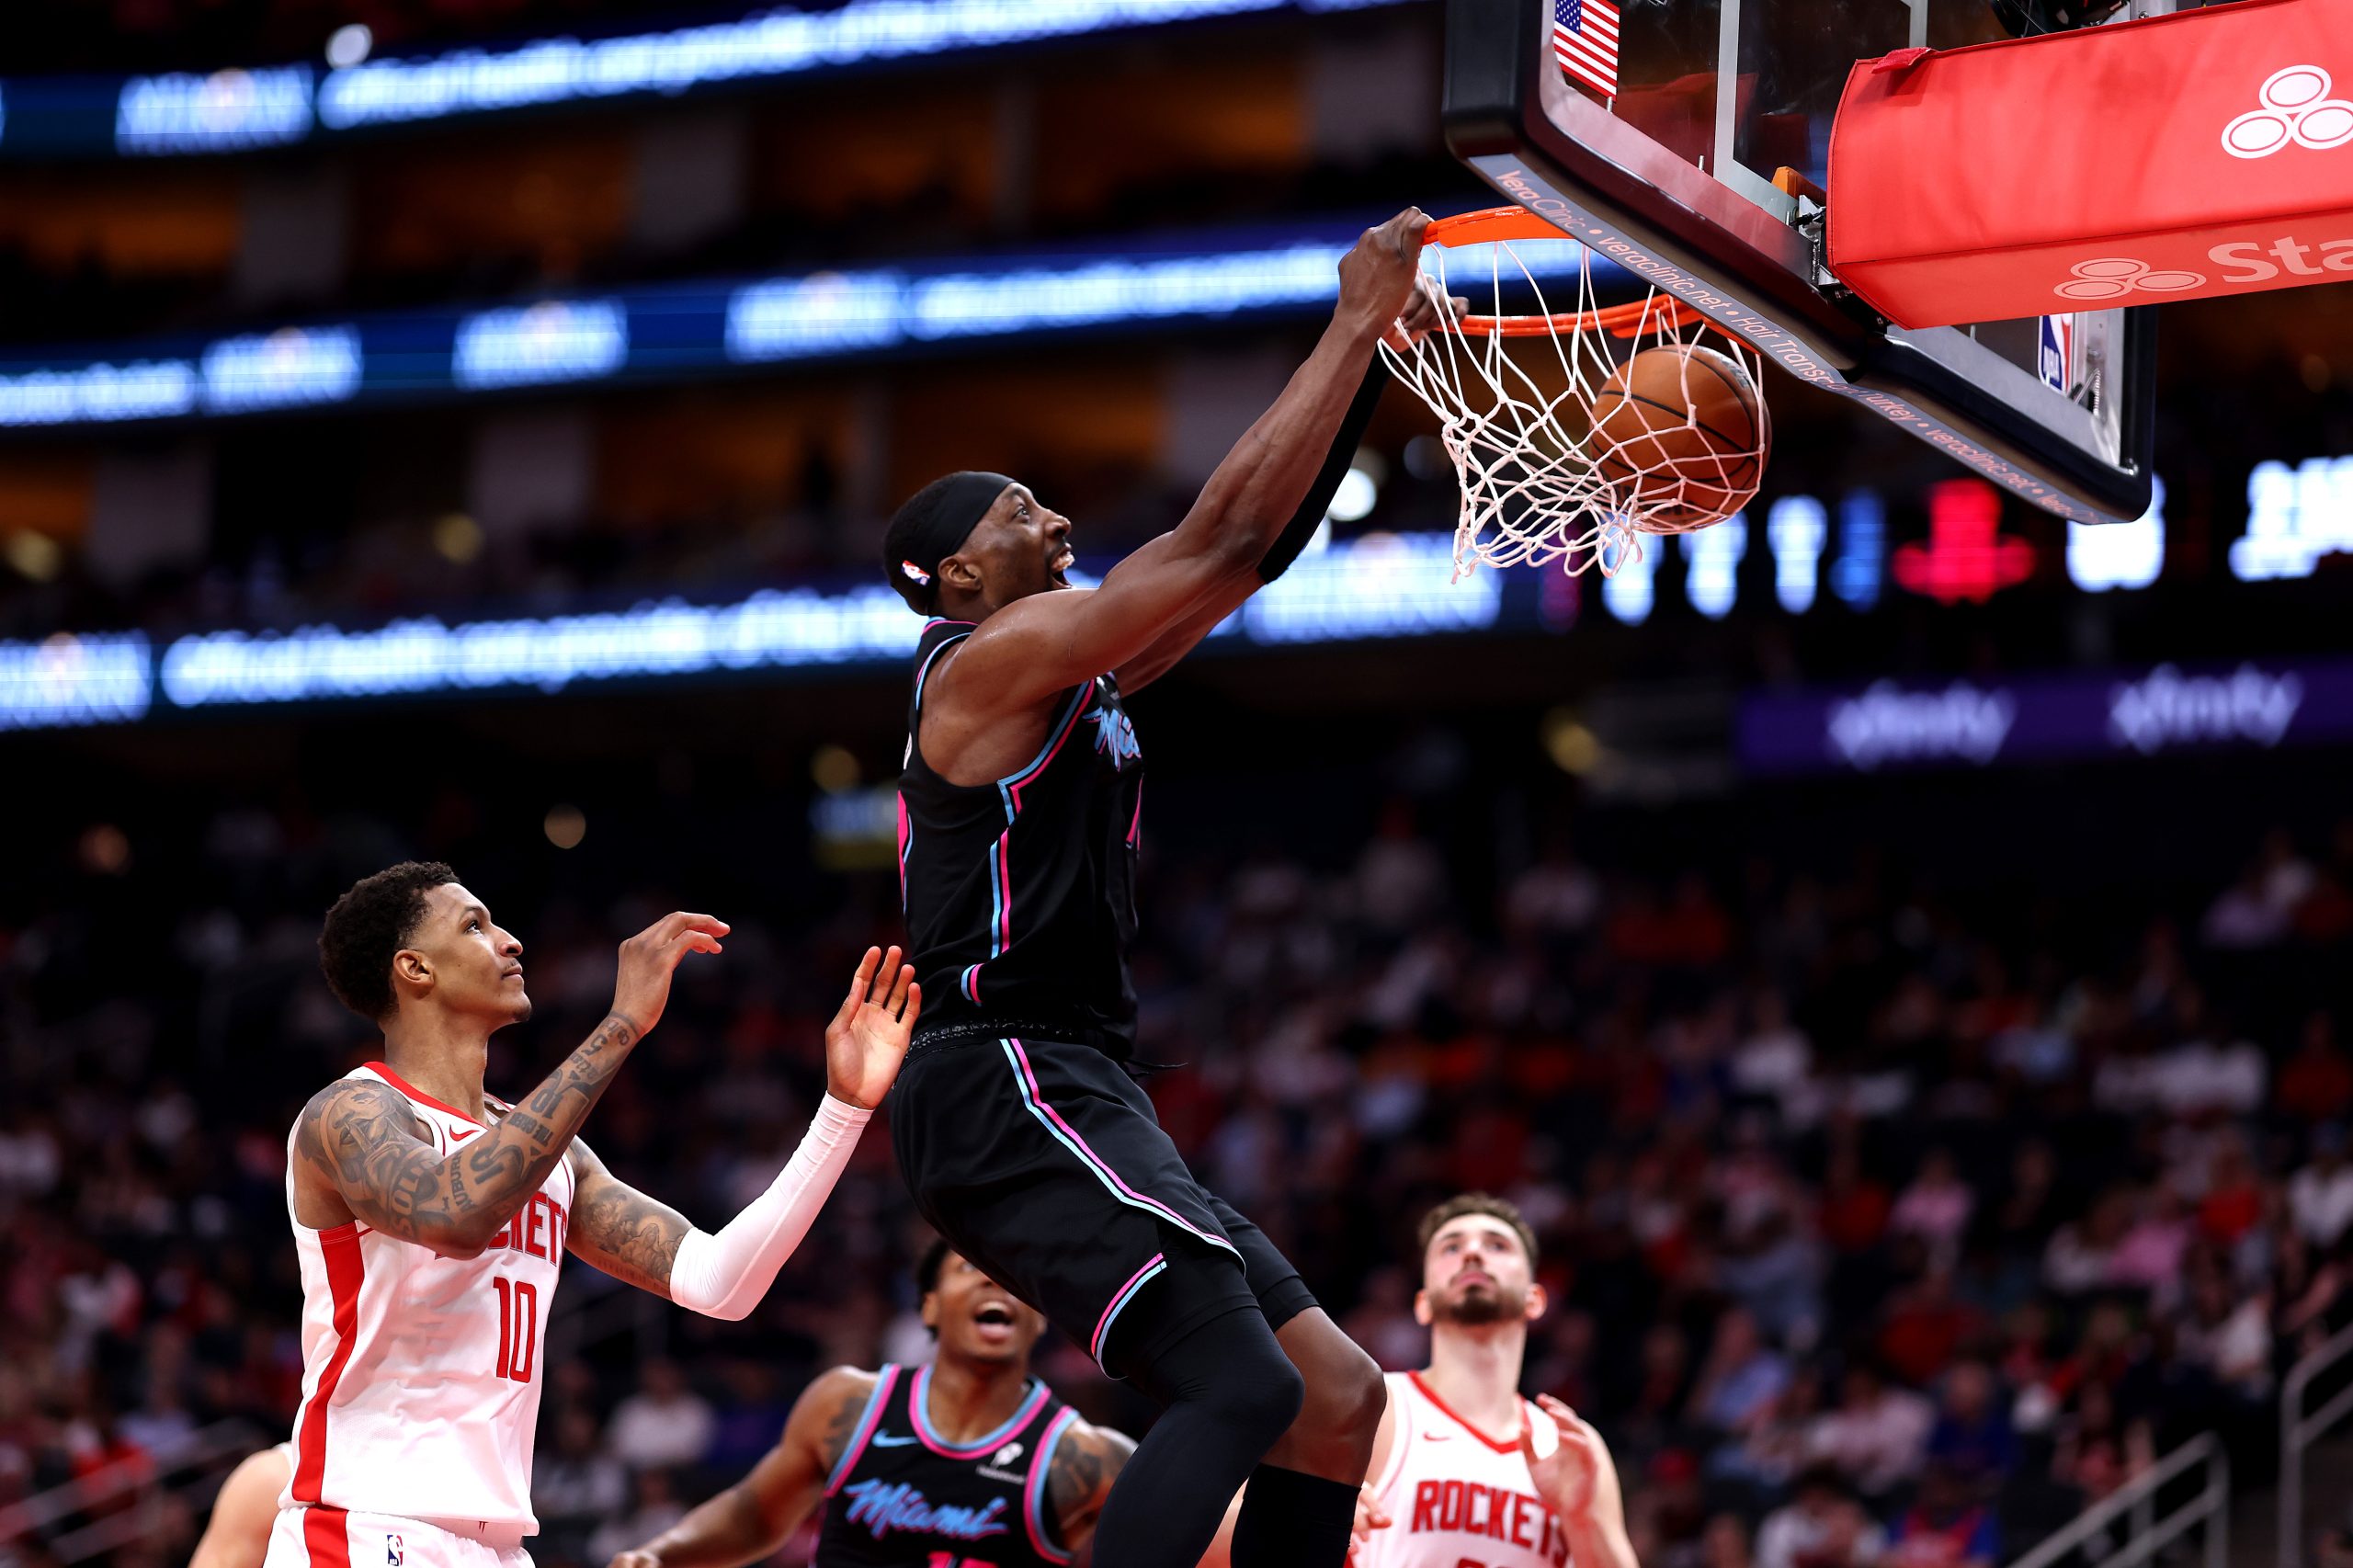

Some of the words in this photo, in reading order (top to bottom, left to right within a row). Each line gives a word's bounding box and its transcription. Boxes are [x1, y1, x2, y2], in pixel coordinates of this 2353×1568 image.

[2208, 236, 2353, 283] Sta
[1731, 316, 1781, 339] Hair
[493, 1277, 538, 1384] 10
[844, 1478, 1009, 1541] Miami
